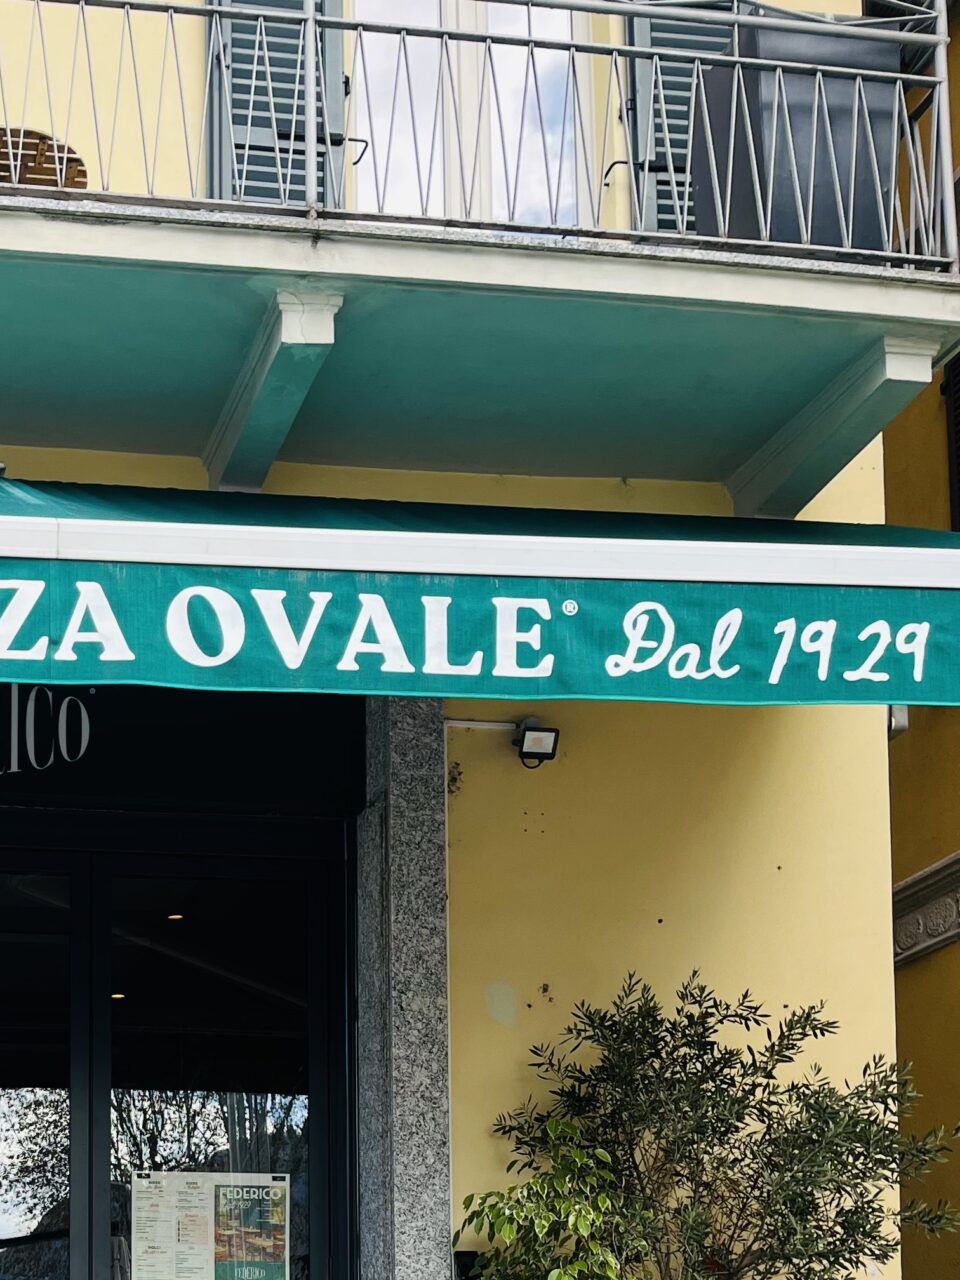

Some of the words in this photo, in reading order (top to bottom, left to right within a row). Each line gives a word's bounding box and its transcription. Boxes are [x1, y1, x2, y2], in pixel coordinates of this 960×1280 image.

[605, 601, 743, 681] Dal
[767, 617, 931, 685] 1929
[219, 1187, 282, 1200] FEDERICO
